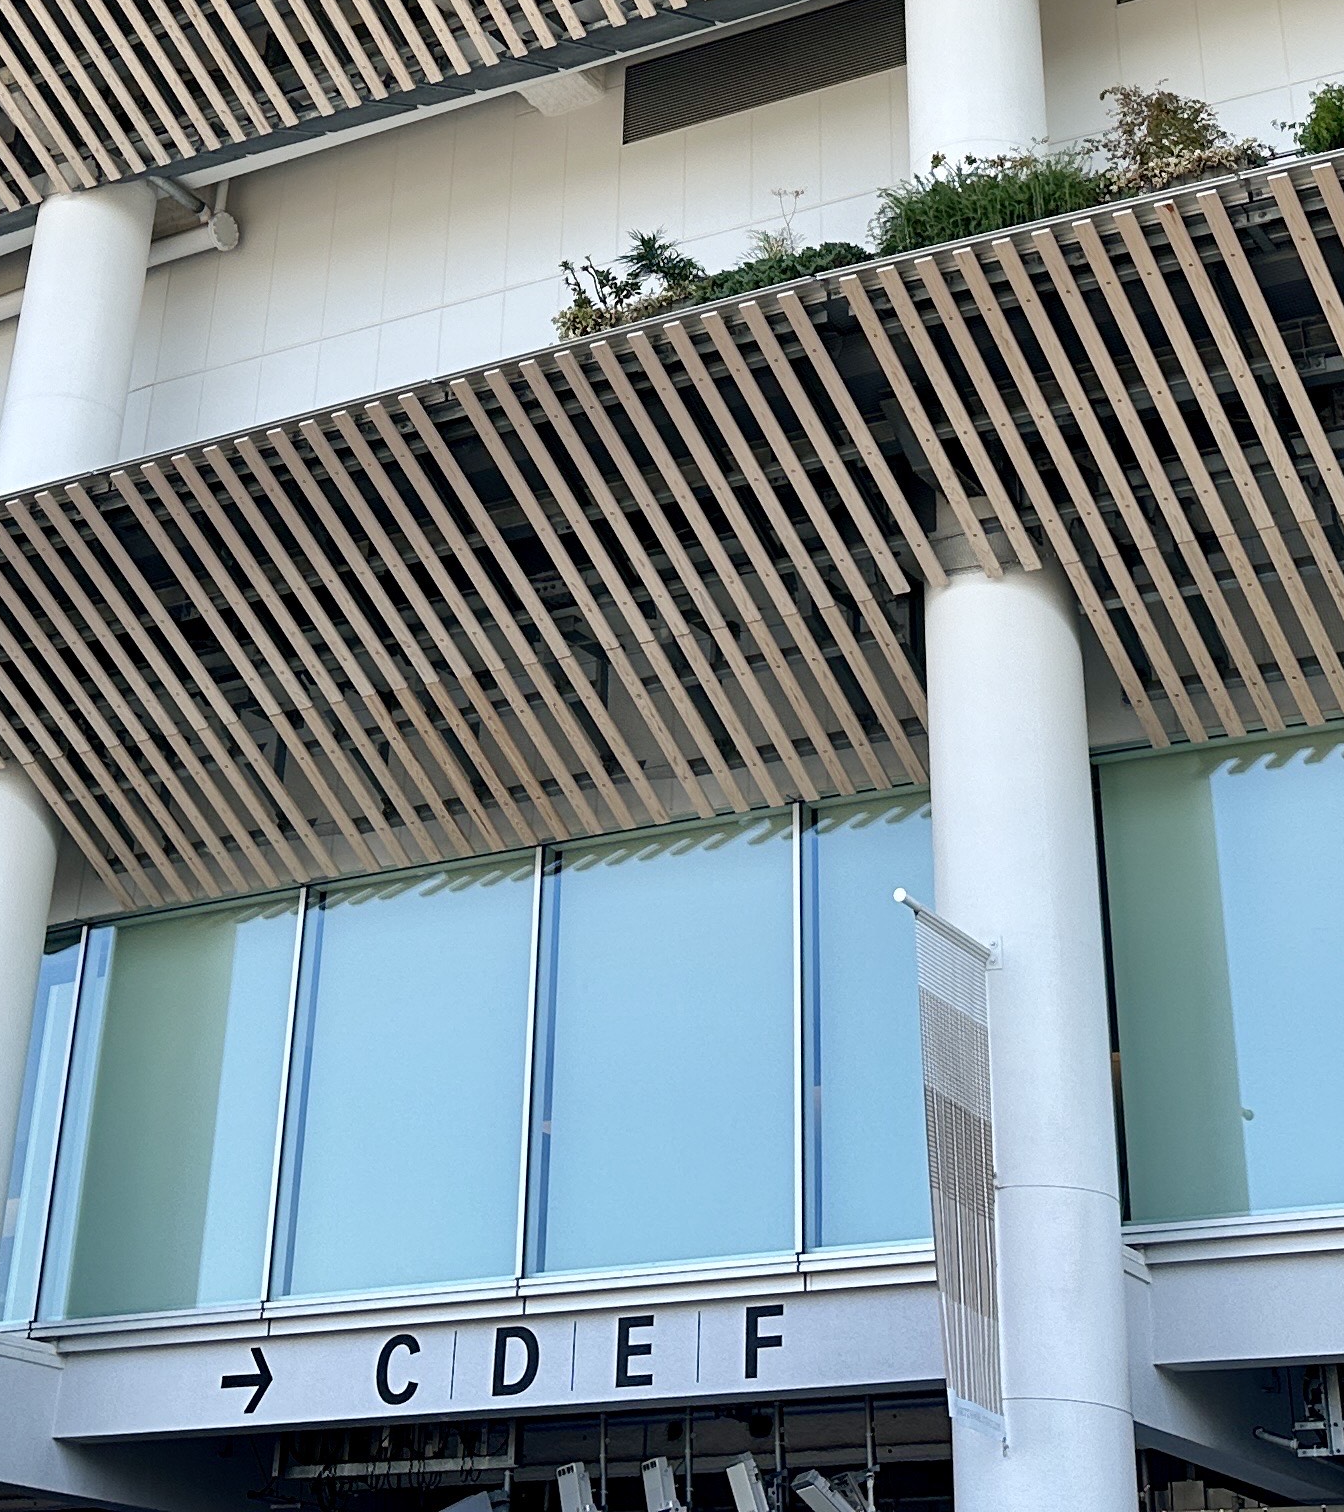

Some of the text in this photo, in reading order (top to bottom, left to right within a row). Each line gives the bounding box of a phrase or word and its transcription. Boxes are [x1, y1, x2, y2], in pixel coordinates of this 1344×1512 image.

[375, 1304, 784, 1405] C D E F
